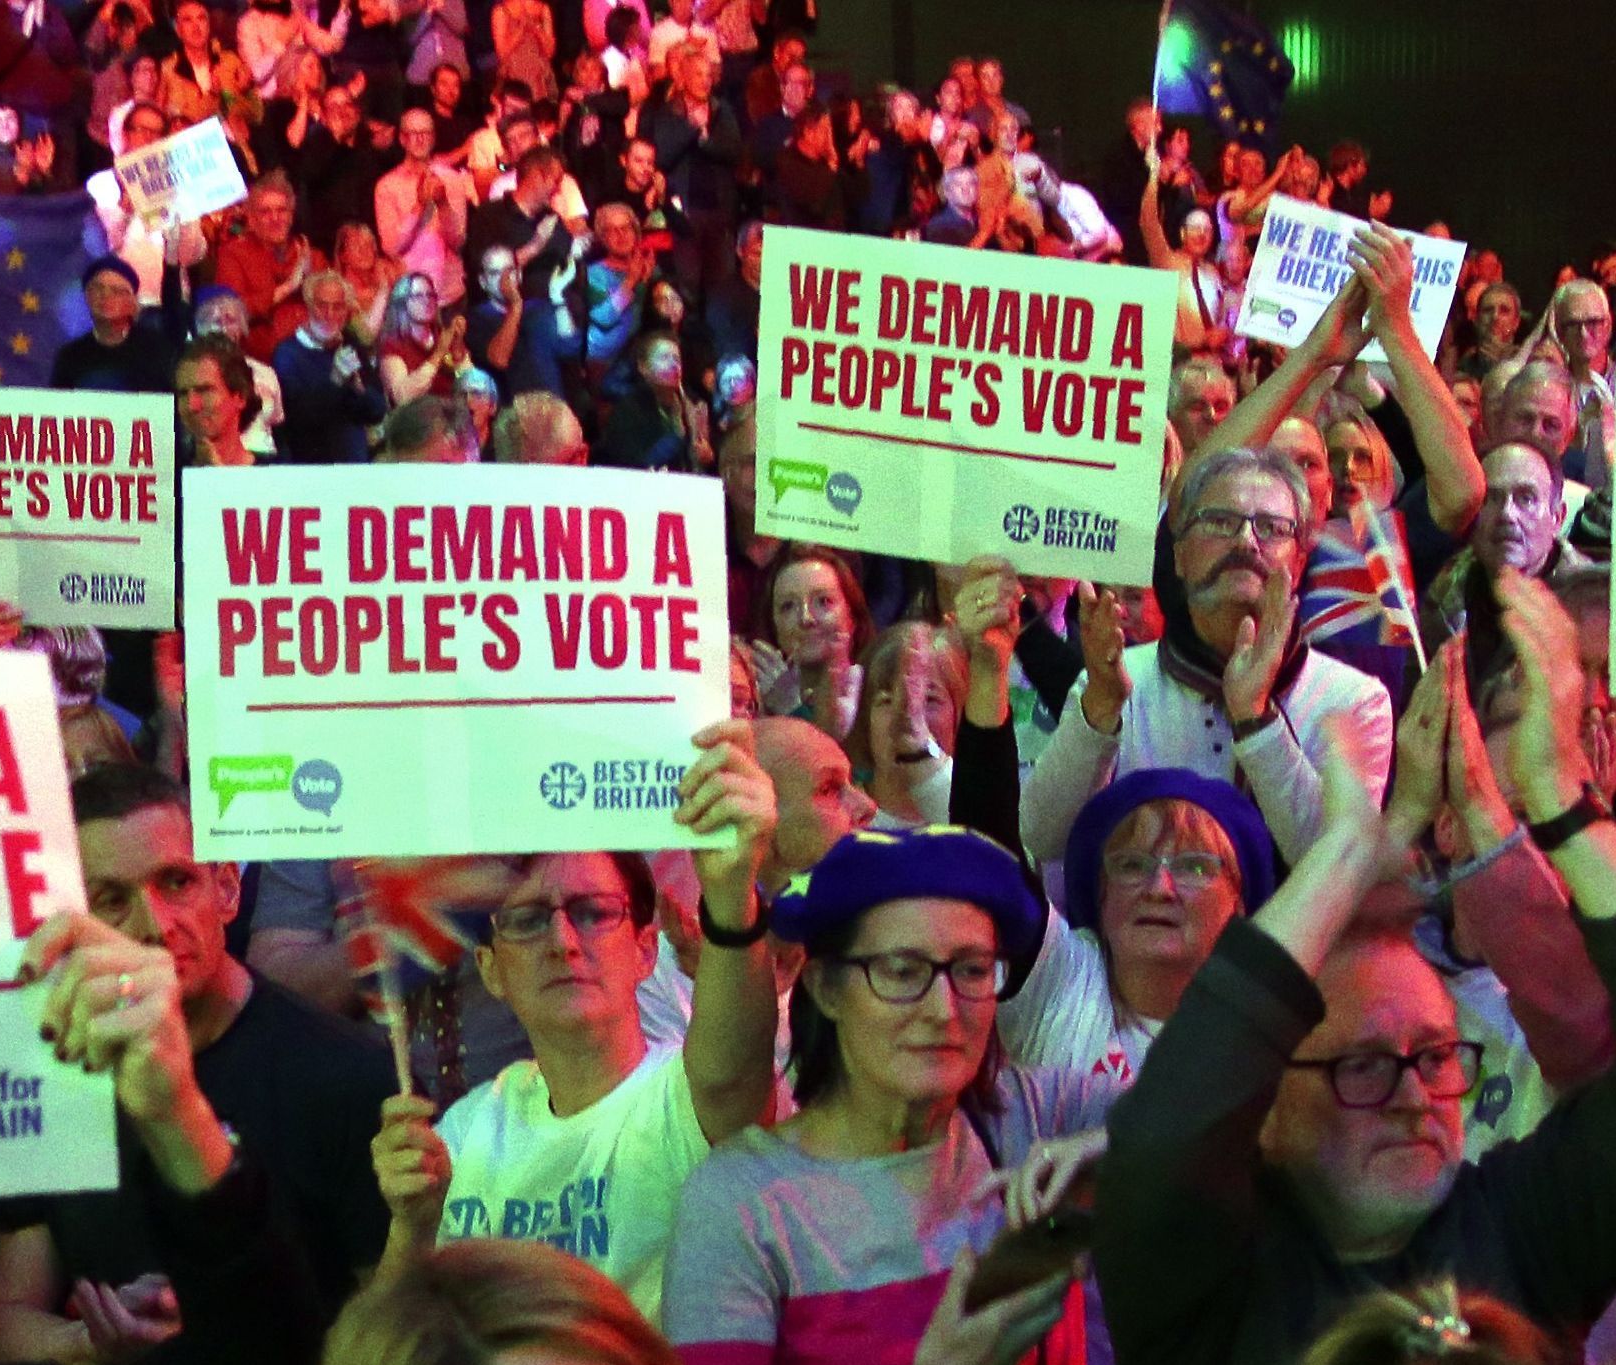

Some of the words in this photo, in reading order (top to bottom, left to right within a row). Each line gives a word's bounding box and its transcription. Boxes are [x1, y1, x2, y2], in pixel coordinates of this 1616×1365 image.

[1265, 213, 1306, 253] WE
[1412, 253, 1455, 287] HIS
[789, 263, 862, 336] WE
[877, 274, 1095, 365] DEMAND
[1110, 302, 1145, 371] A
[780, 336, 1004, 429] PEOPLE'S
[1021, 368, 1146, 446] VOTE
[129, 417, 154, 468] A
[63, 471, 158, 523] VOTE
[1045, 506, 1089, 532] BEST
[1094, 511, 1119, 533] for
[222, 506, 322, 586] WE
[348, 505, 629, 583] DEMAND
[653, 512, 693, 587] A
[1043, 527, 1117, 553] BRITAIN
[90, 587, 146, 605] BRITAIN
[91, 572, 125, 590] BEST
[218, 593, 521, 678] PEOPLE'S
[545, 592, 702, 675] VOTE
[298, 777, 336, 793] Vote
[593, 760, 649, 784] BEST
[655, 757, 687, 784] for
